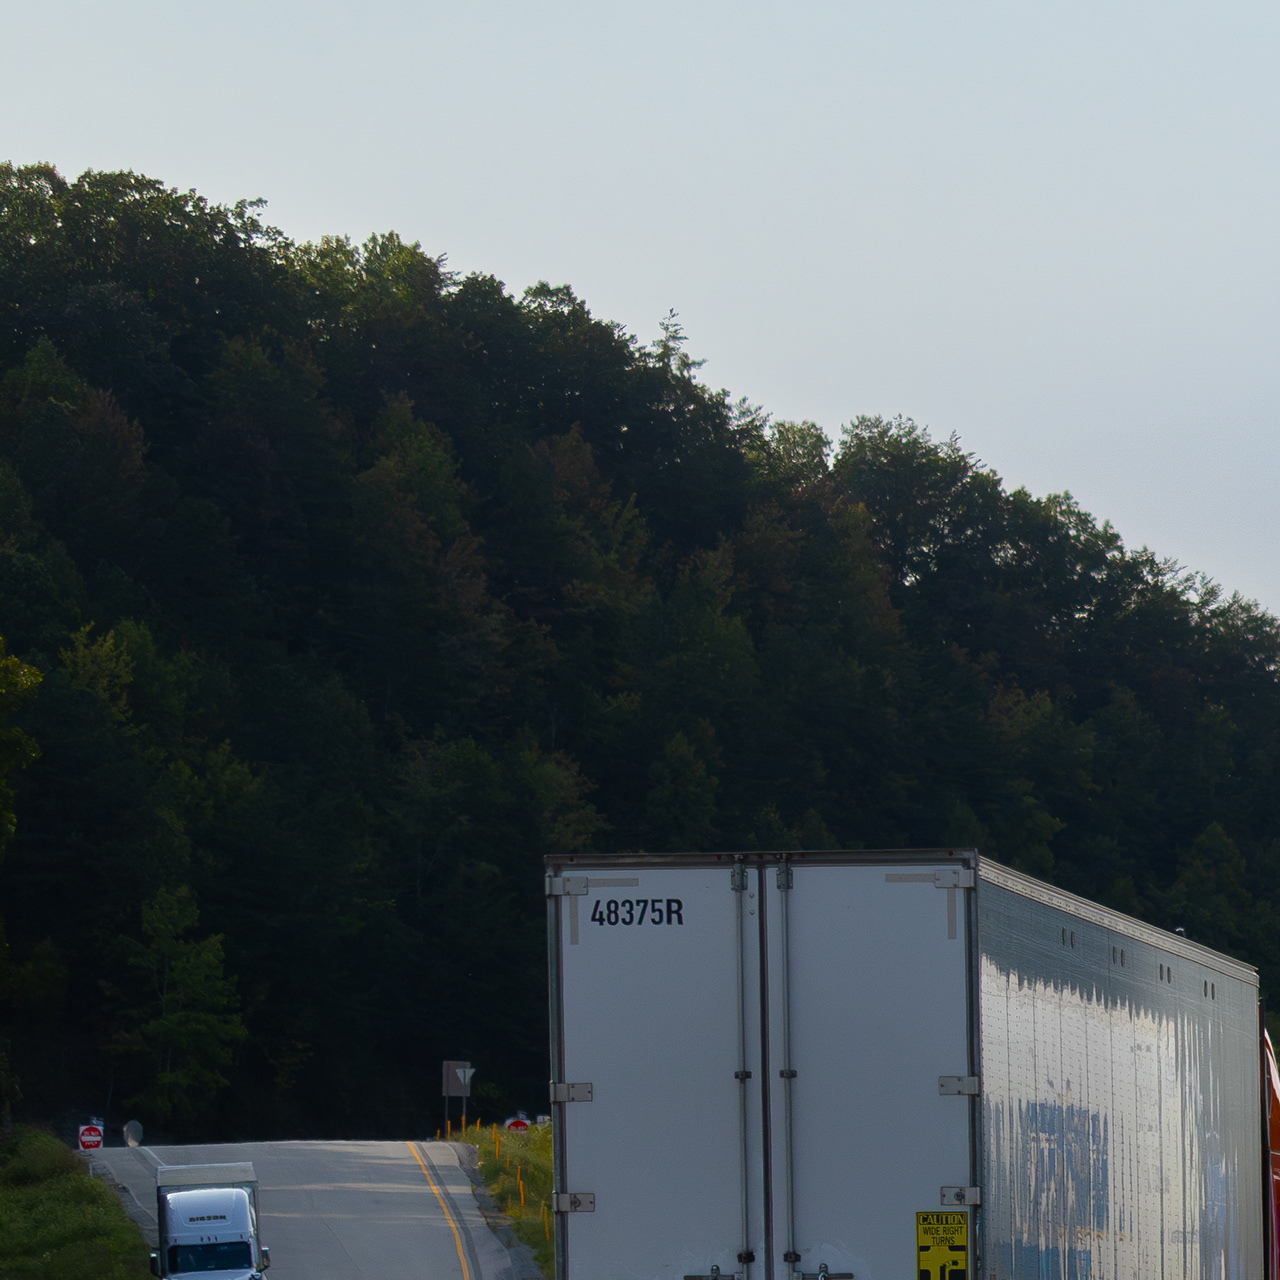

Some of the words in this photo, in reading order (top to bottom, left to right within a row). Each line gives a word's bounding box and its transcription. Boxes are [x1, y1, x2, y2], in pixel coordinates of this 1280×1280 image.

[591, 899, 684, 926] 48375R
[919, 1214, 965, 1225] CAUTION
[922, 1226, 940, 1235] WIDE
[942, 1226, 963, 1235] RIGHT
[931, 1236, 955, 1245] TURNS
